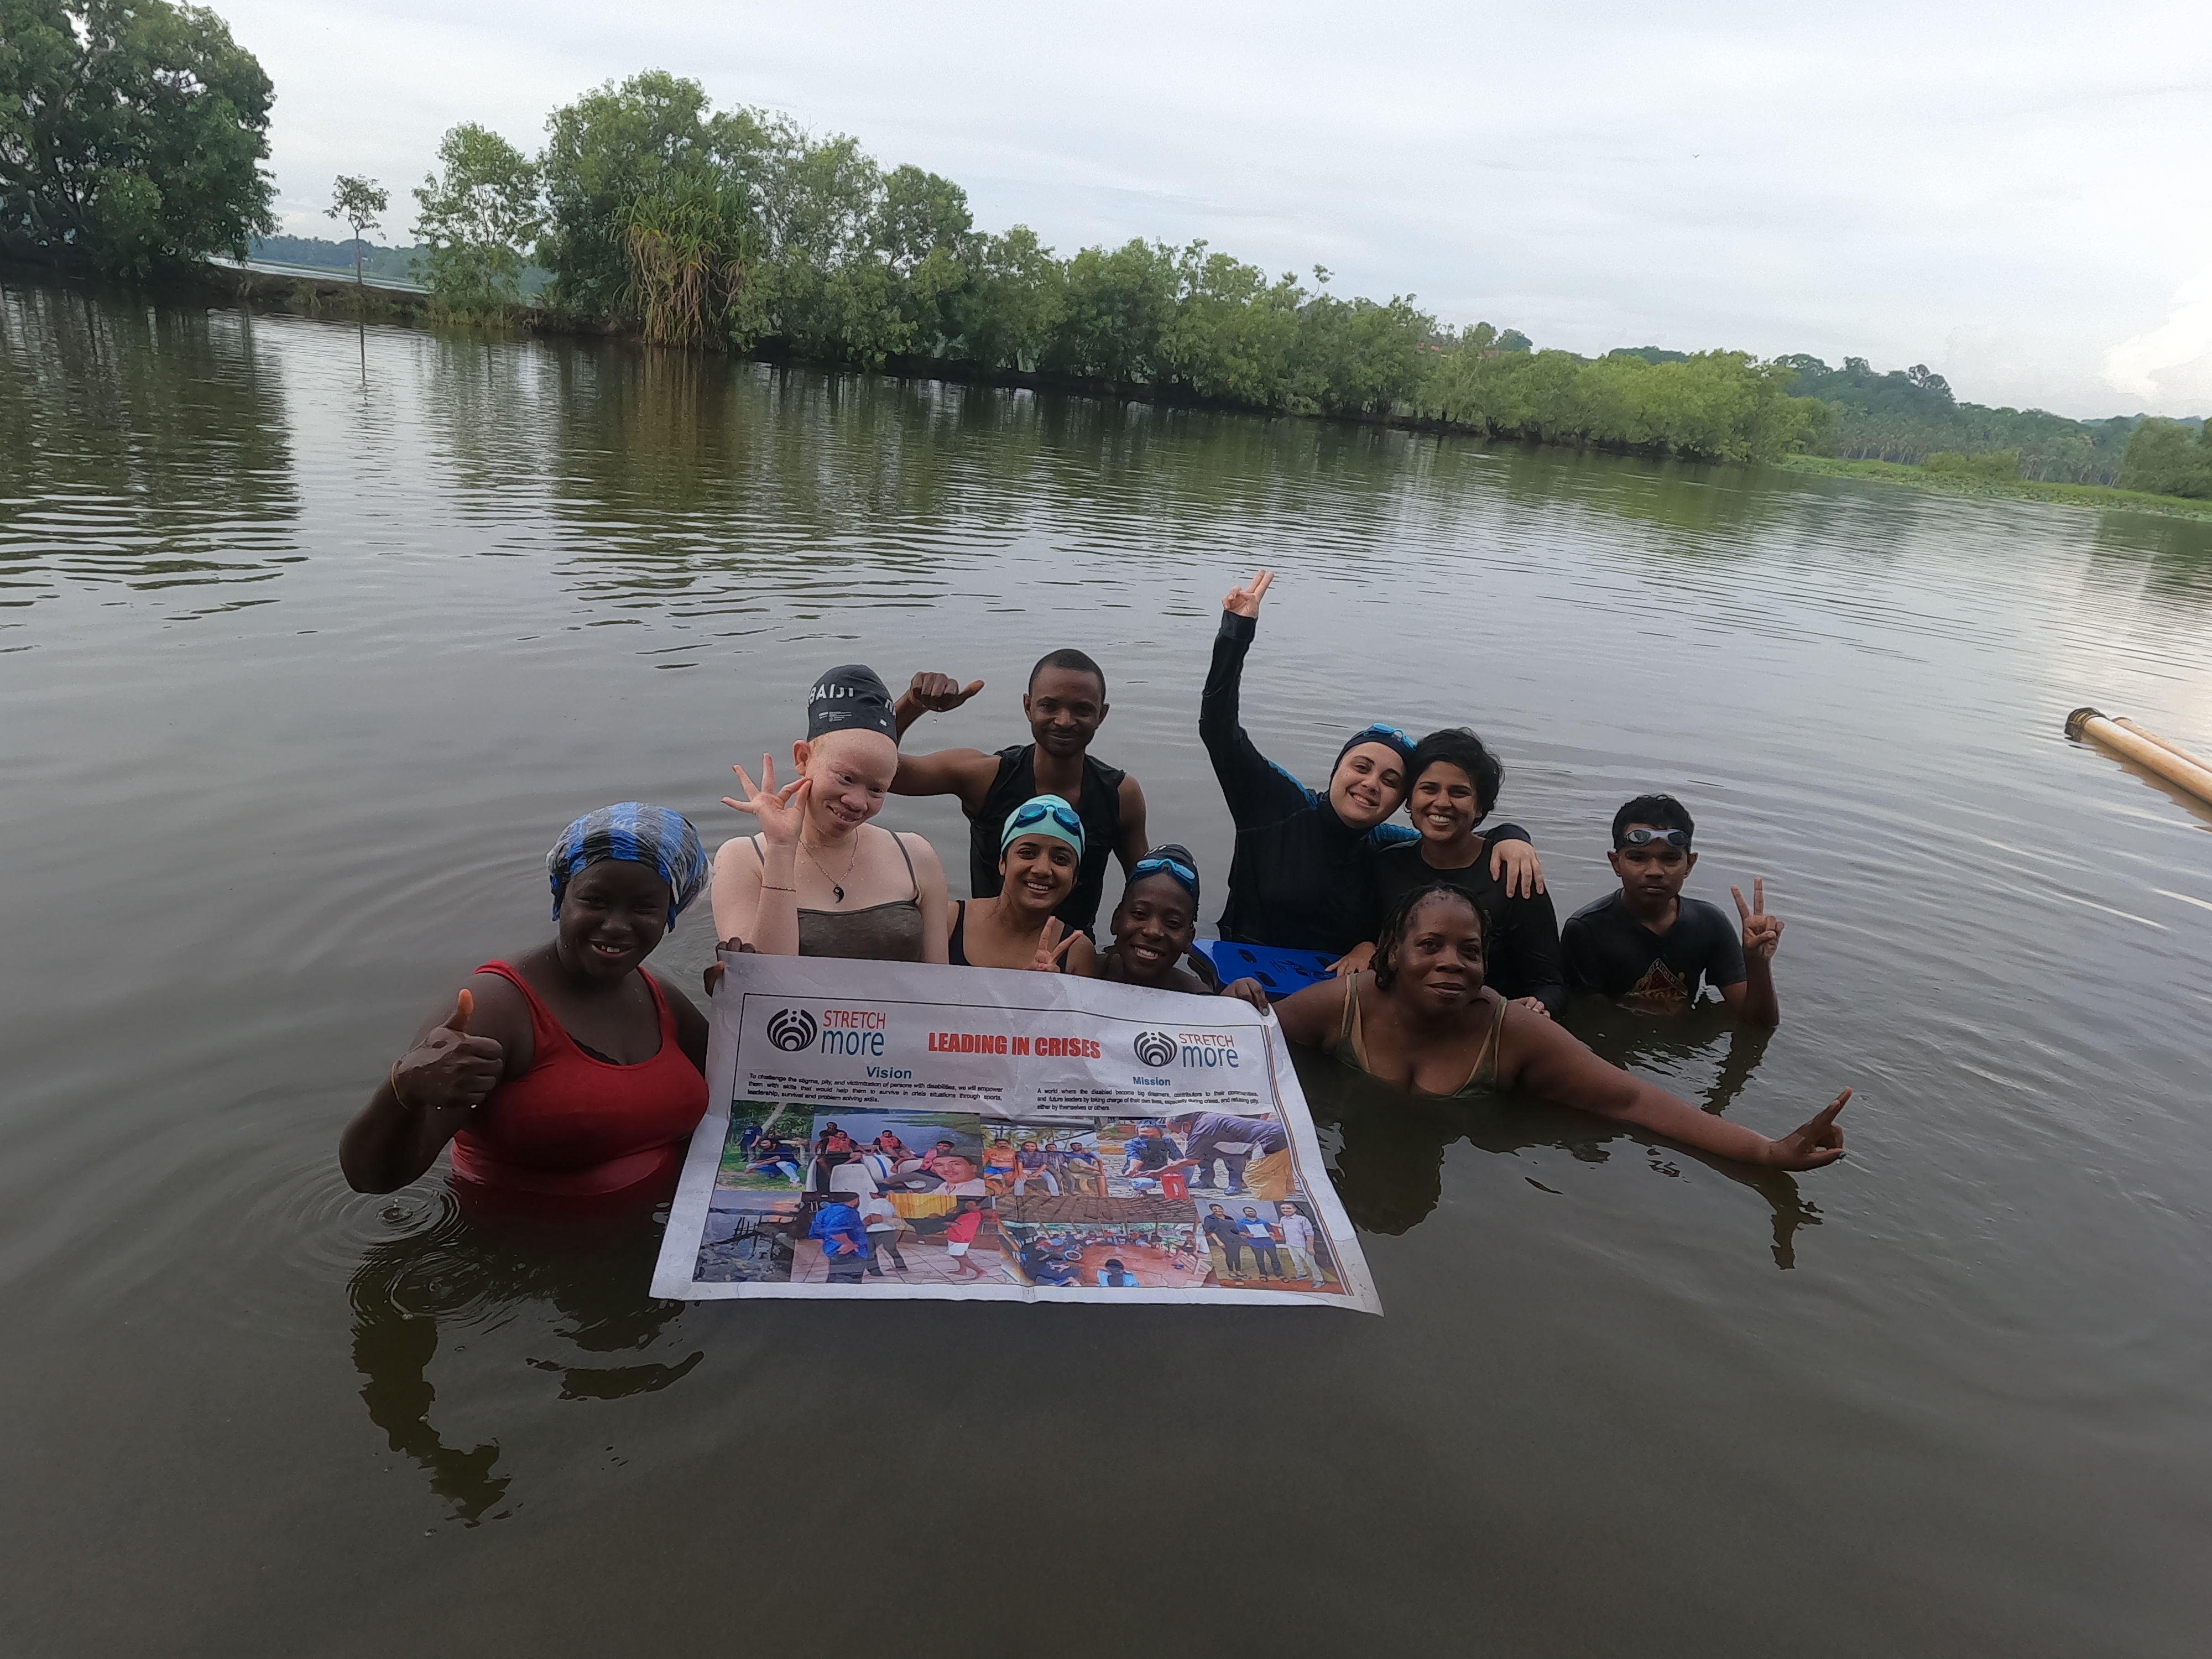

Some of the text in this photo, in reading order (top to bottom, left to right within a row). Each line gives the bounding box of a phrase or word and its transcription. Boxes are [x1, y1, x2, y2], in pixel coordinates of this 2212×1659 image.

[808, 684, 854, 707] BAIJI
[823, 1010, 886, 1029] STRETCH
[821, 1030, 884, 1056] more
[928, 1032, 1101, 1059] LEADING IN CRISES
[1179, 1033, 1235, 1047] STRETCH
[1182, 1046, 1239, 1068] more
[867, 1066, 912, 1078] Vision
[1133, 1077, 1171, 1086] Mission
[748, 1089, 779, 1097] leadership,
